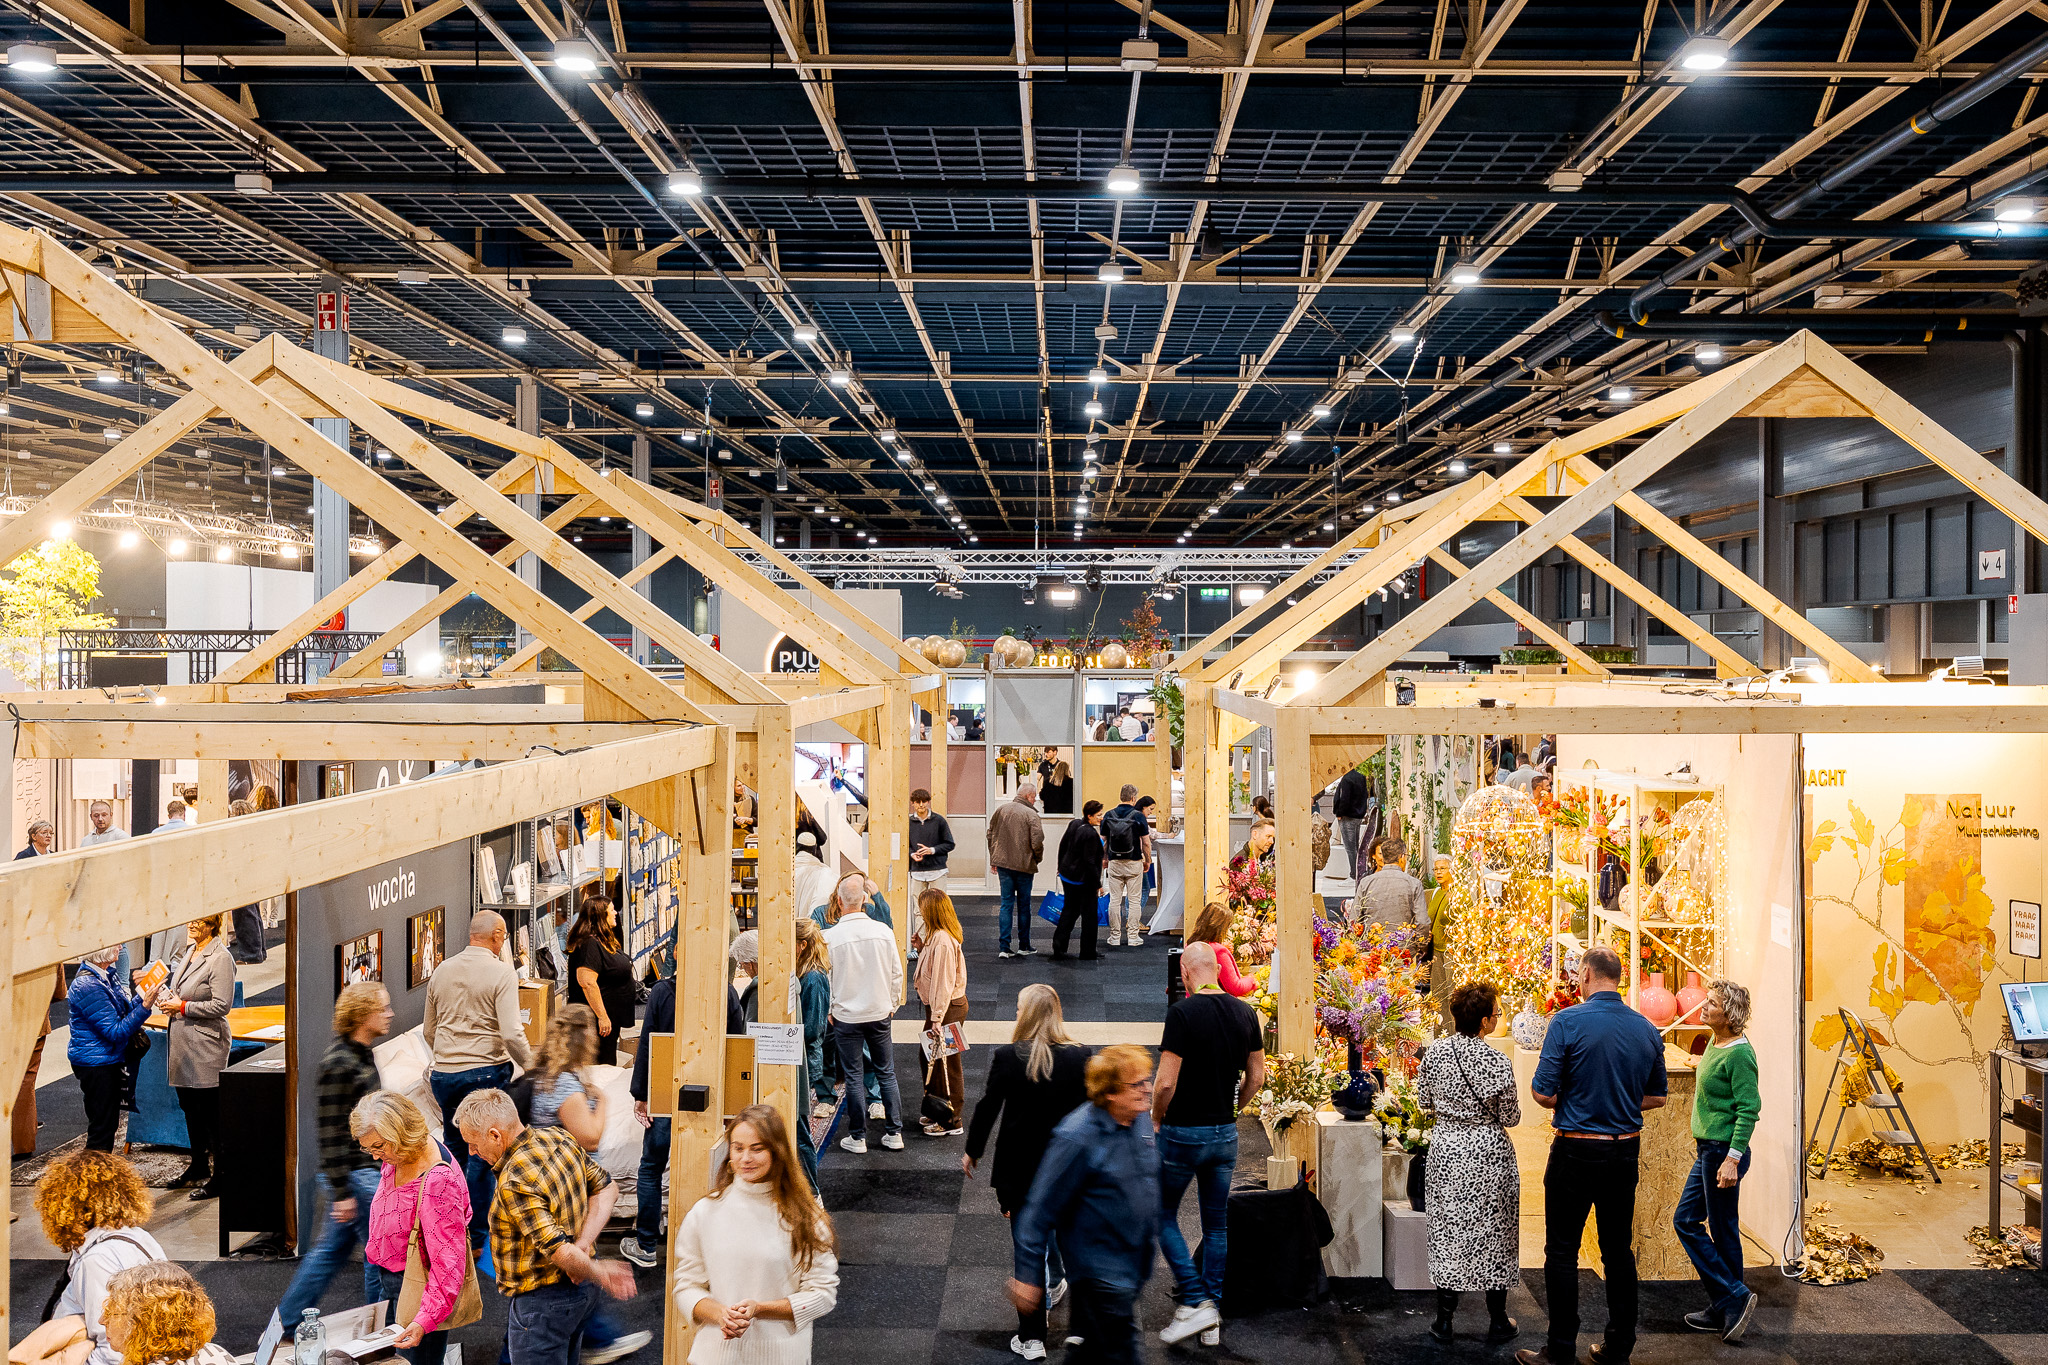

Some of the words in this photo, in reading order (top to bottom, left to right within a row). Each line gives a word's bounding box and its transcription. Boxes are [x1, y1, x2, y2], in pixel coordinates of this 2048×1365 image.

[1995, 556, 2002, 572] 4
[382, 662, 397, 673] utters
[1946, 799, 2016, 819] Natuur
[1956, 824, 2040, 841] Muurschildering
[367, 865, 417, 911] wocha
[2013, 910, 2037, 921] VRAAG
[2015, 920, 2036, 931] MAAR
[2015, 930, 2036, 942] RAAK!
